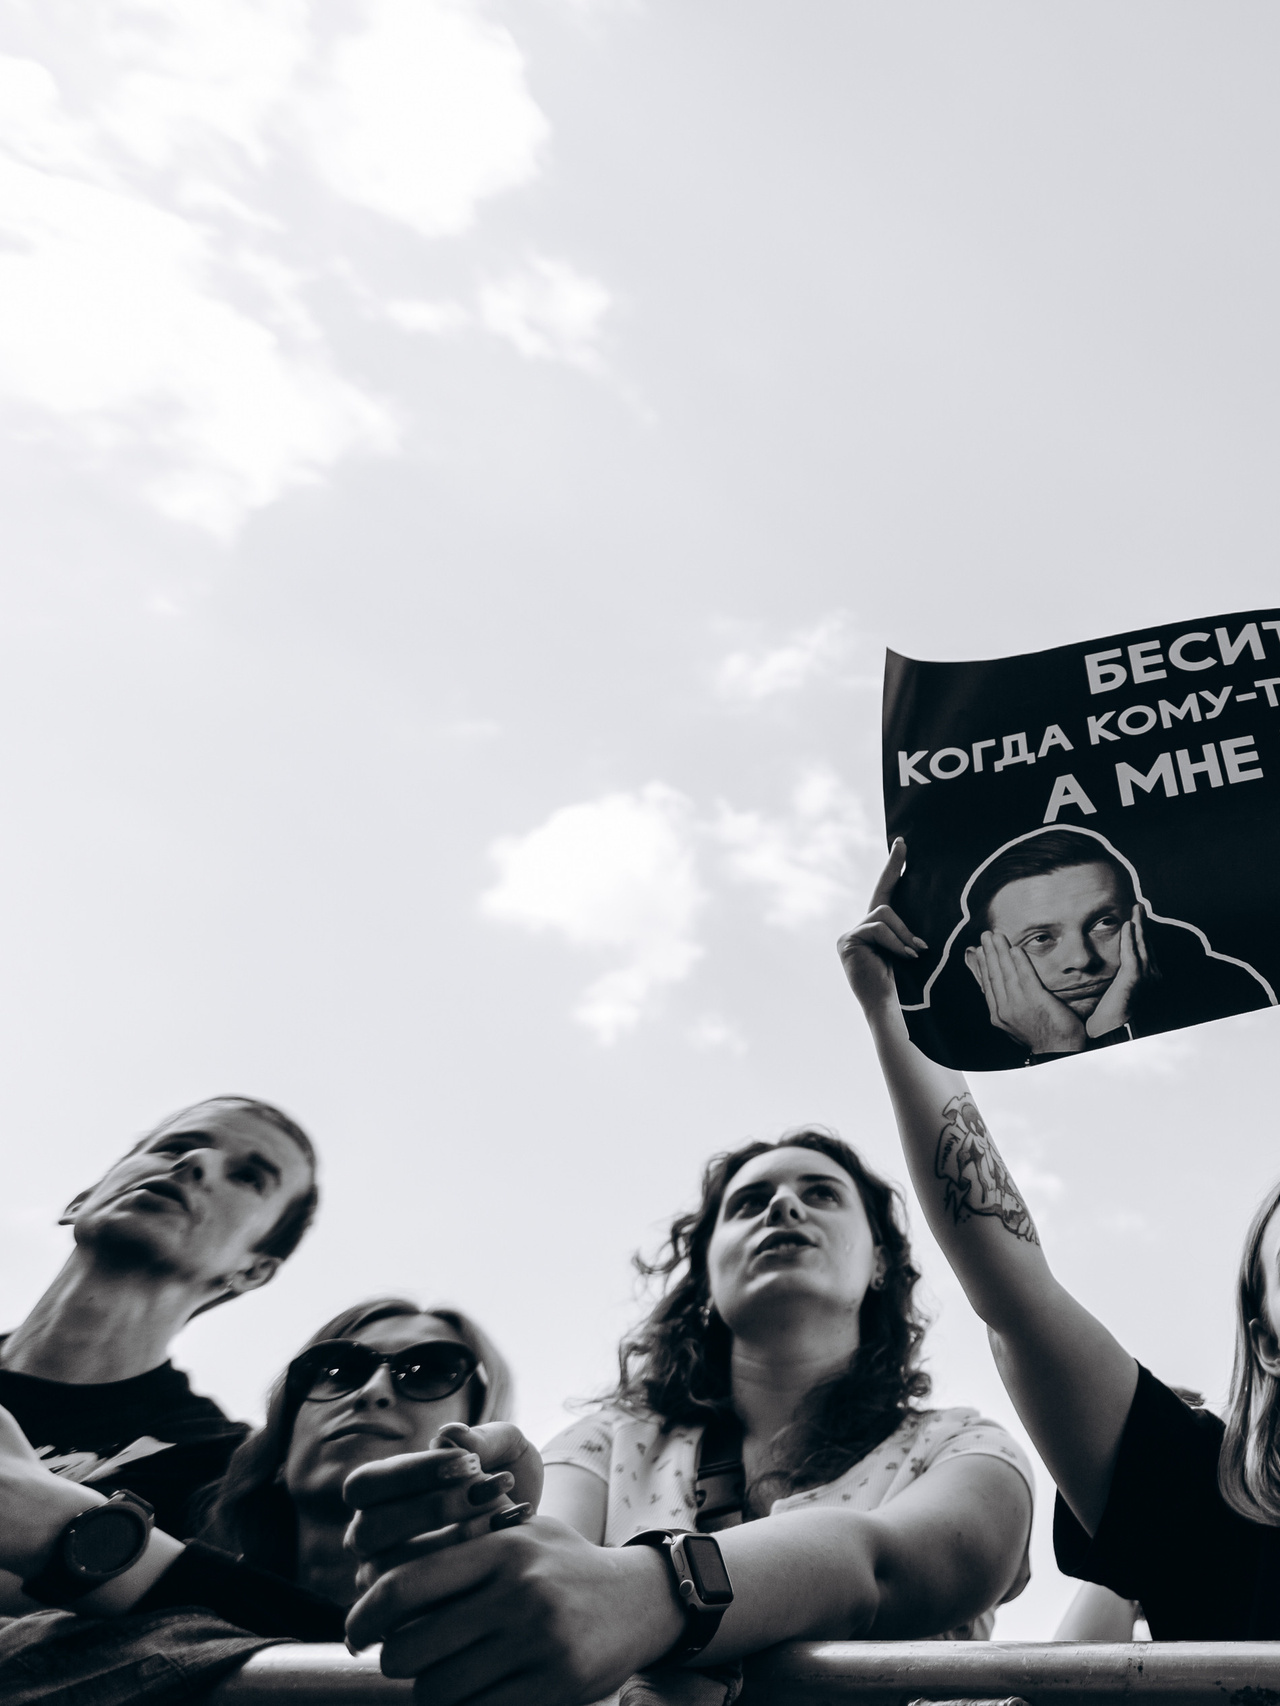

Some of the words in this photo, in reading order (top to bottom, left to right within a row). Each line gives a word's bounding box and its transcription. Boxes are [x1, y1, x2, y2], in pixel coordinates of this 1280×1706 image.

[898, 723, 1075, 787] КОГДА
[1043, 774, 1098, 825] А
[1115, 735, 1264, 808] МНЕ
